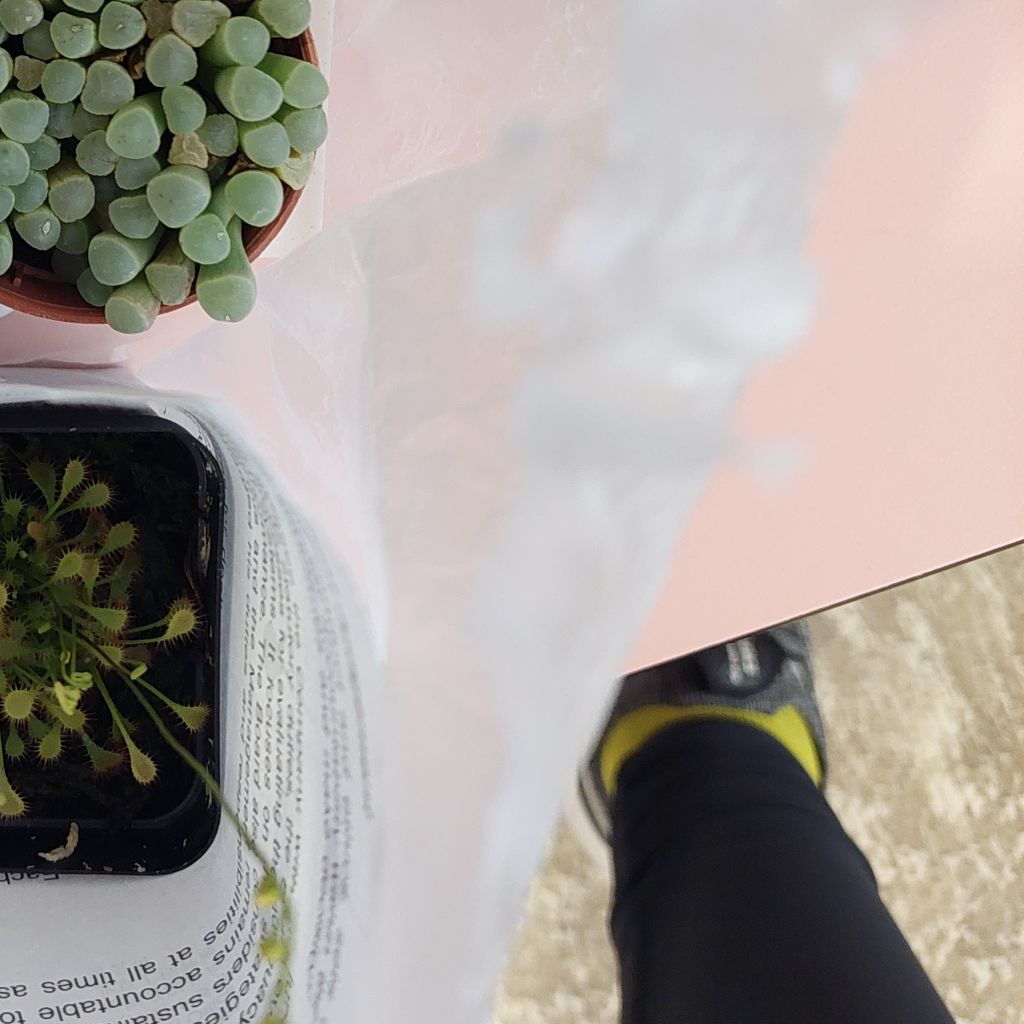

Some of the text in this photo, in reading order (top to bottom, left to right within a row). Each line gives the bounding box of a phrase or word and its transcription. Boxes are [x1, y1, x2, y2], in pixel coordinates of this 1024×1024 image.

[167, 946, 192, 967] at
[41, 971, 115, 995] times
[126, 961, 157, 983] all
[38, 967, 203, 1022] accountable
[0, 1010, 25, 1024] to
